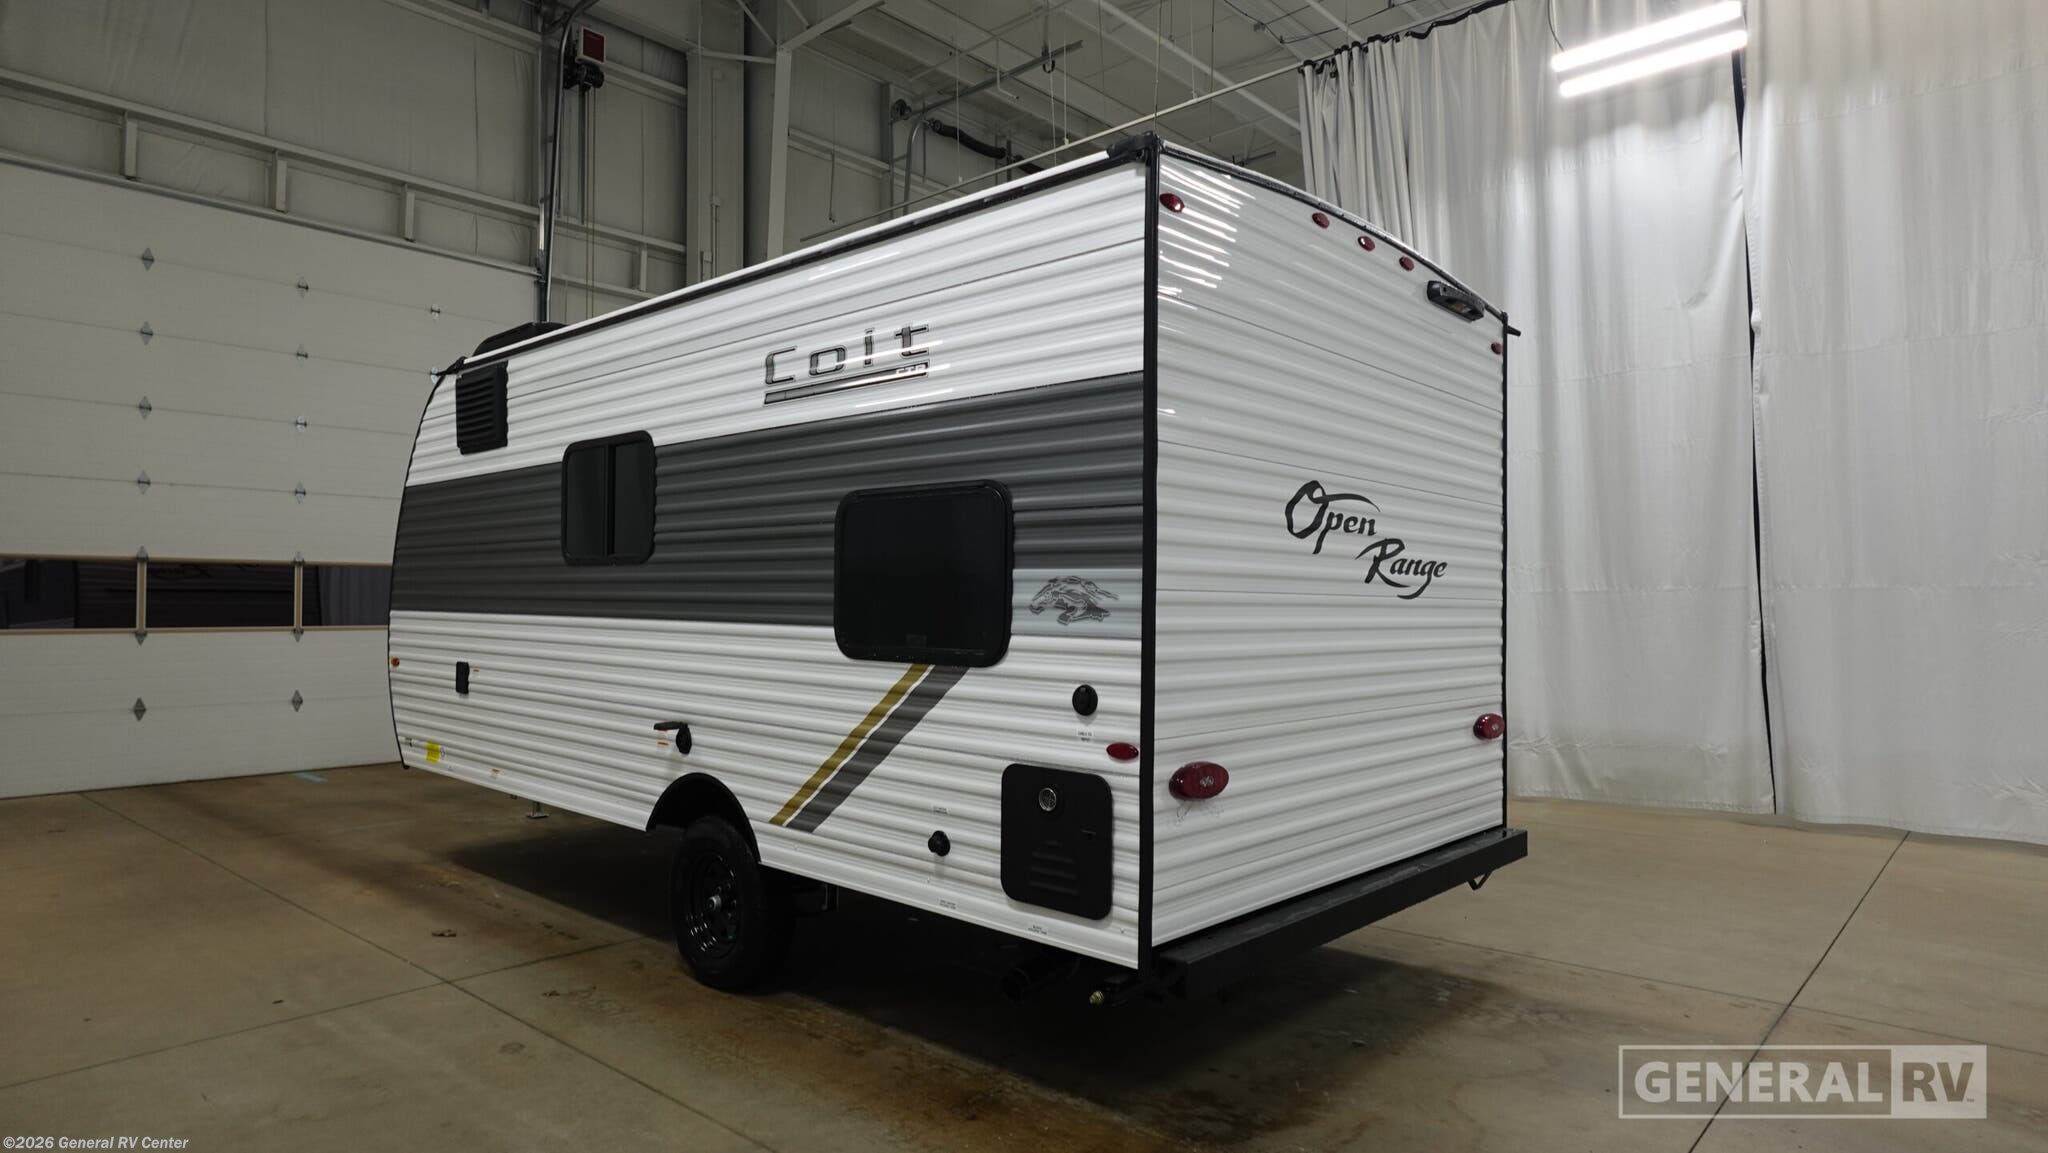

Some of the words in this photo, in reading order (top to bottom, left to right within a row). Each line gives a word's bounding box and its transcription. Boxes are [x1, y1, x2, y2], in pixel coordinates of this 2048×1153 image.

[765, 323, 929, 385] Colt
[1285, 480, 1381, 555] Open
[1354, 538, 1448, 600] Range
